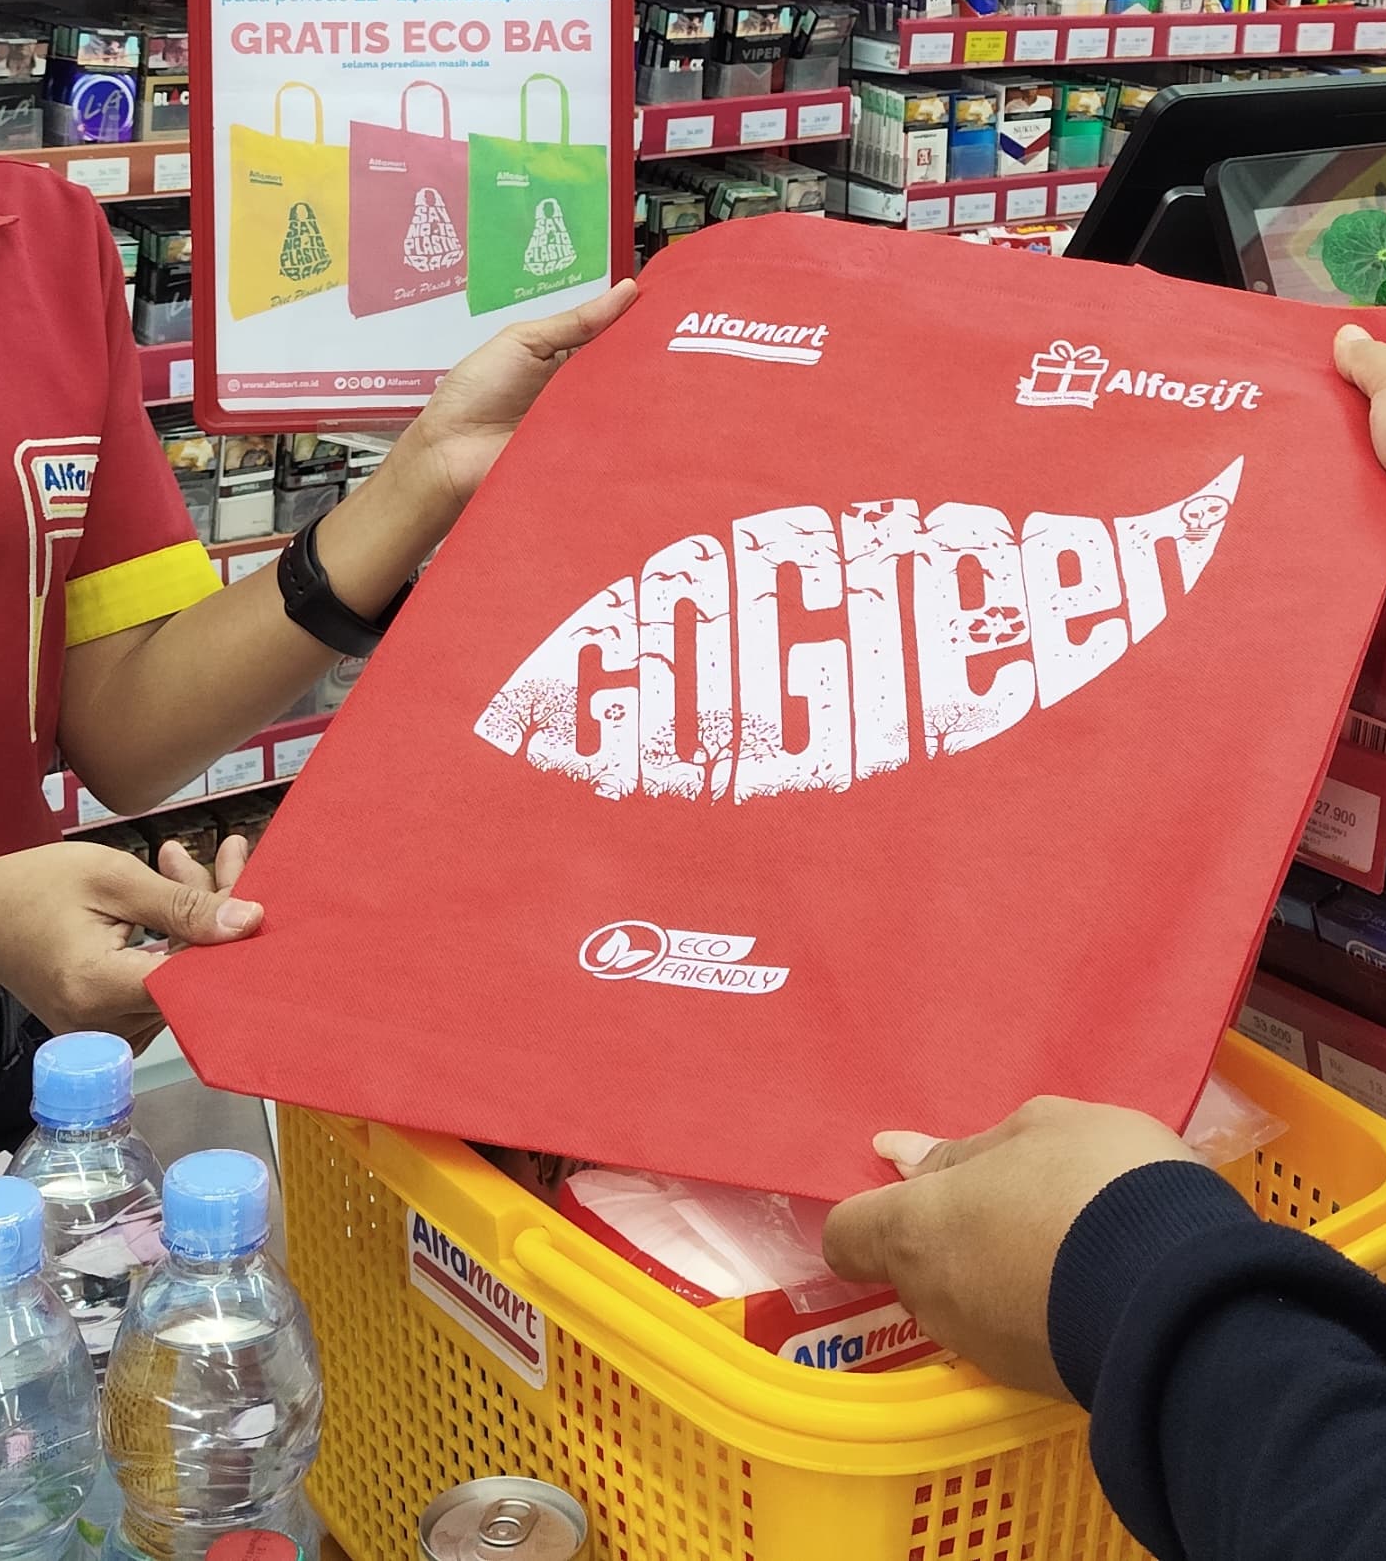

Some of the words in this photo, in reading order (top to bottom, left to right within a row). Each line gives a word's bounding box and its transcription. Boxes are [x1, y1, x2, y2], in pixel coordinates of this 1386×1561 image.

[230, 20, 391, 56] GRATIS
[402, 19, 491, 56] ECO
[504, 18, 592, 54] BAG
[742, 47, 781, 61] VIPER
[341, 59, 379, 70] selama
[380, 59, 437, 71] persediaan
[439, 58, 468, 69] masih
[470, 58, 490, 69] ada
[669, 57, 704, 73] BLACK
[1013, 124, 1041, 135] SUKUN
[414, 205, 450, 224] SAY
[287, 220, 320, 238] SAY
[533, 218, 567, 236] SAY
[676, 310, 830, 352] Alfamart
[242, 378, 319, 390] www.alfamart.co.id
[387, 376, 421, 387] Alfamart
[1105, 368, 1263, 413] Alfagift
[678, 937, 731, 957] ECO
[658, 962, 779, 989] FRIENDLY
[410, 1210, 540, 1343] Alfamart
